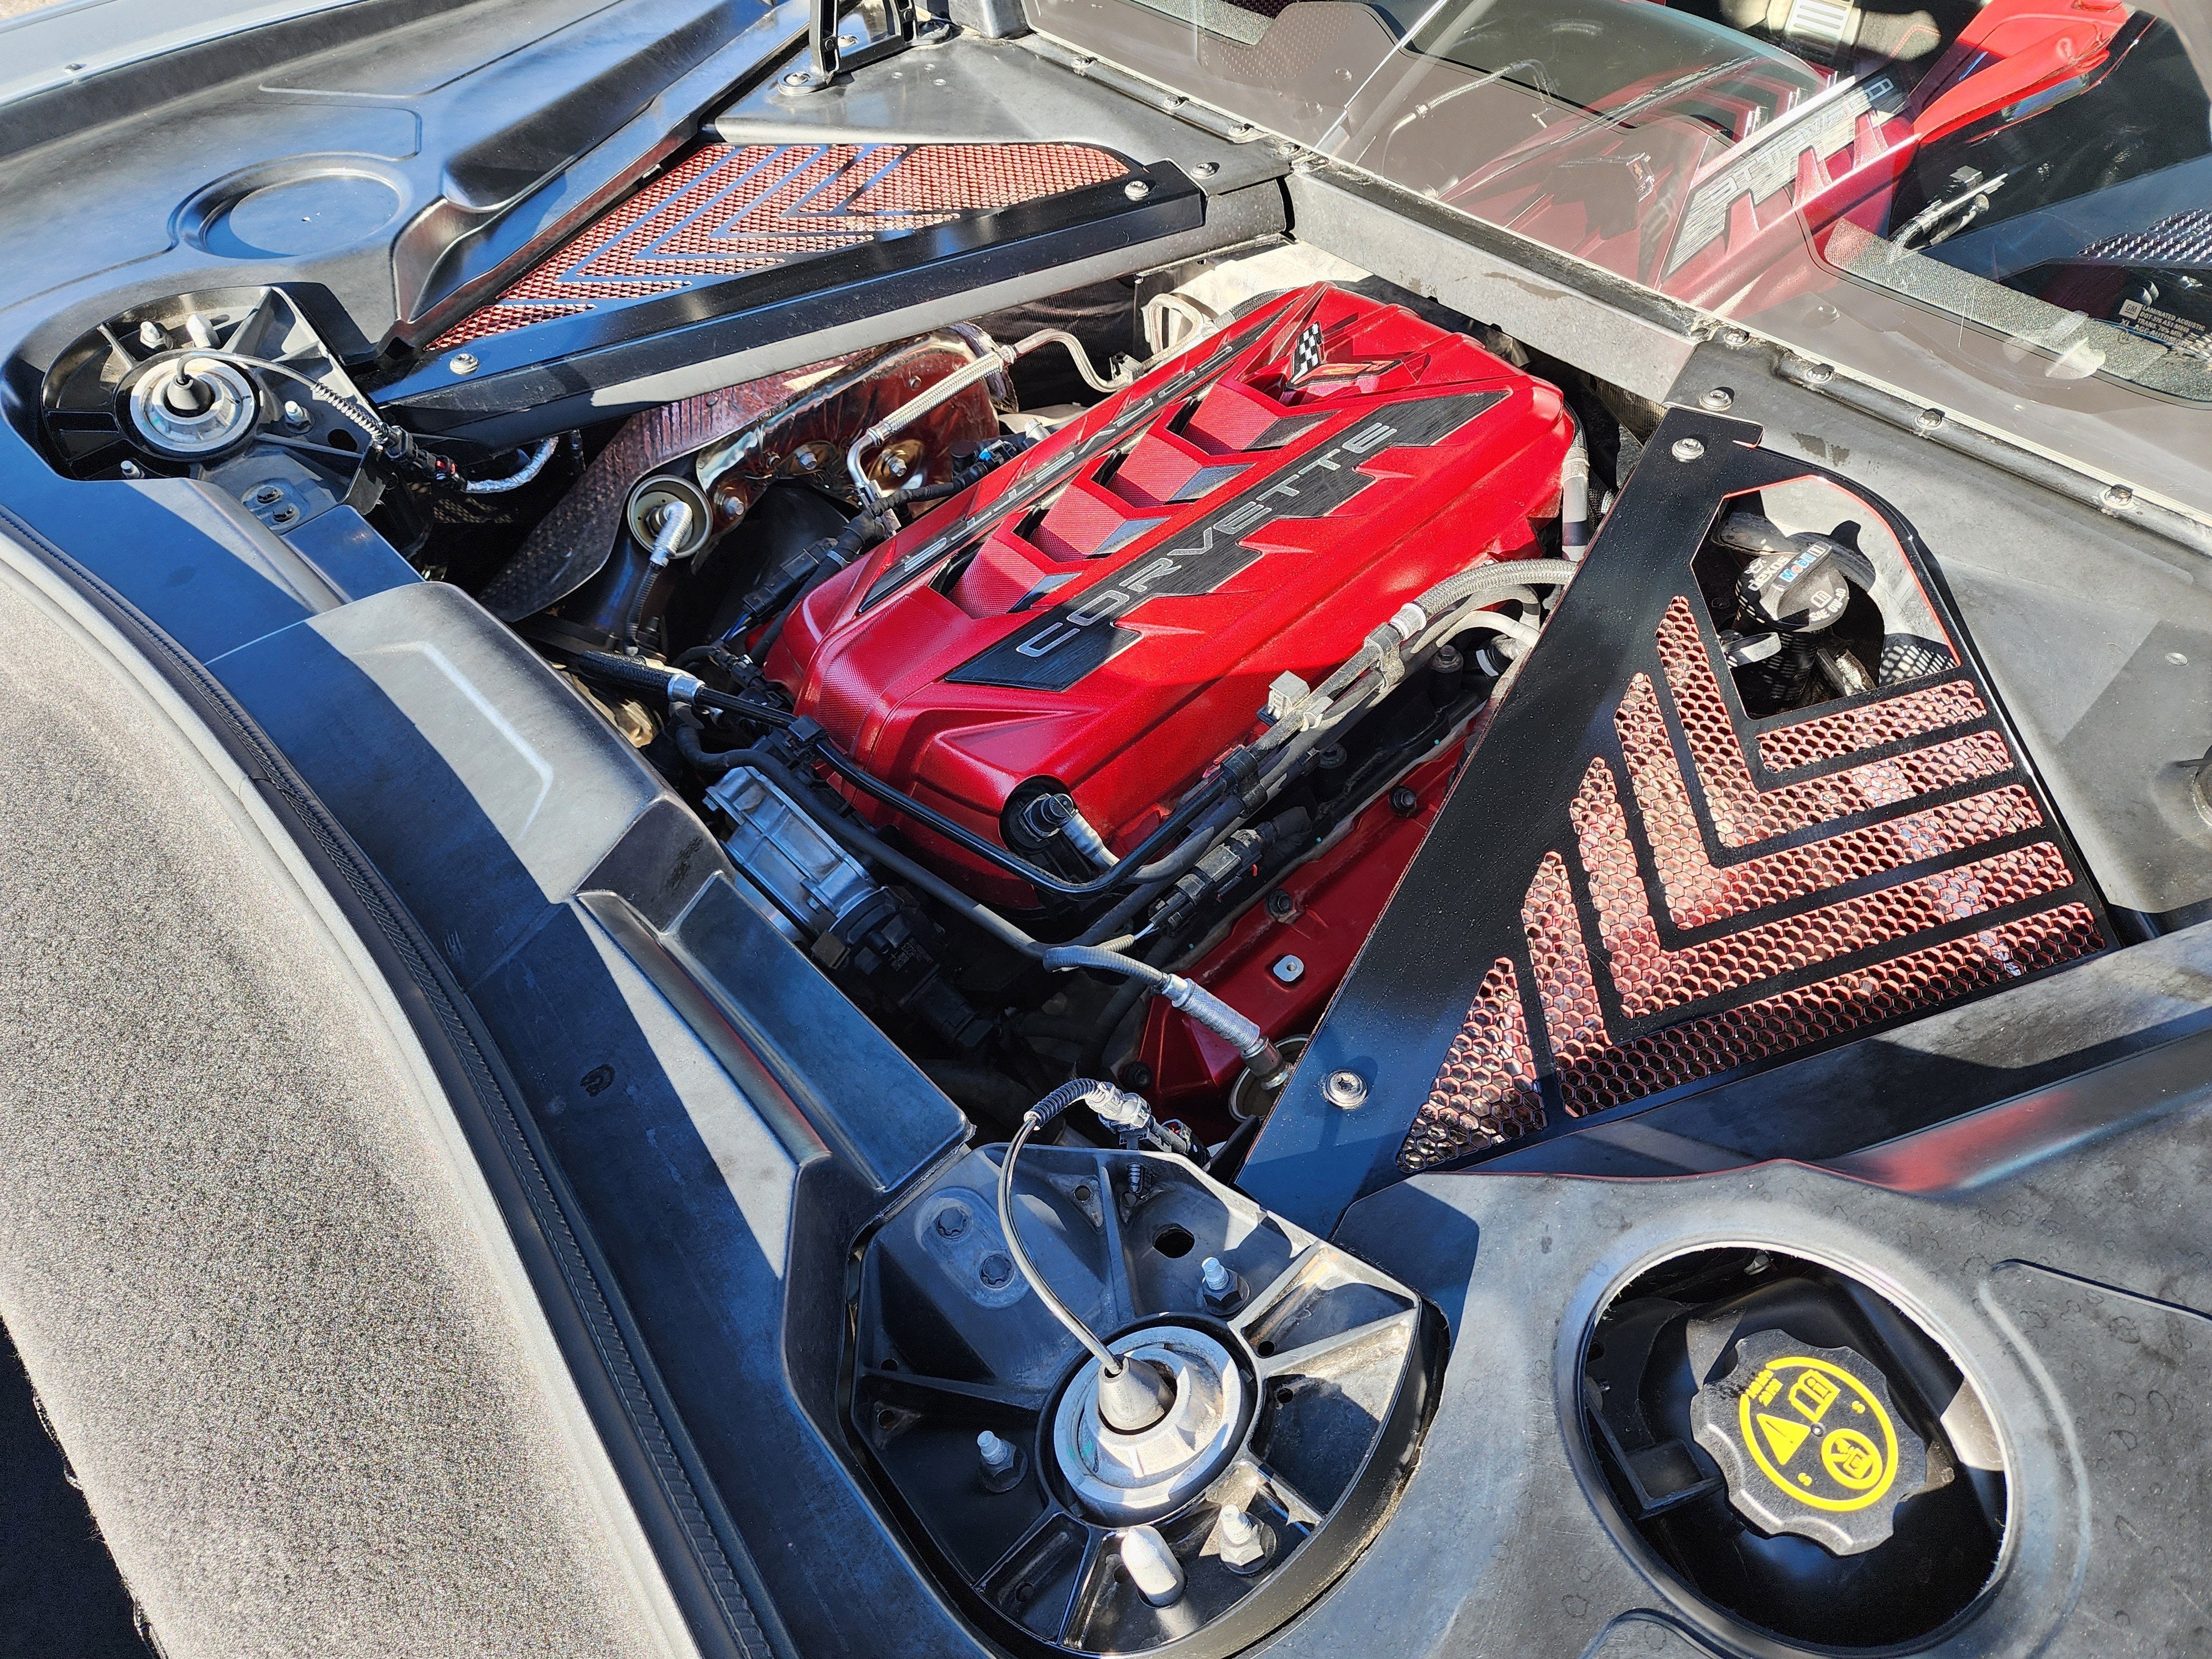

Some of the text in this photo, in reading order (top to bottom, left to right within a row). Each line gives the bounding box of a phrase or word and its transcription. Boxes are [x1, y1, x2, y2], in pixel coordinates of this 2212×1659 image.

[2142, 305, 2206, 332] LAMINATED ACOUSTIC
[1015, 422, 1397, 658] CORVETTE
[1748, 555, 1791, 591] dexos
[1778, 552, 1817, 583] Mobil
[1809, 608, 1830, 622] SAE
